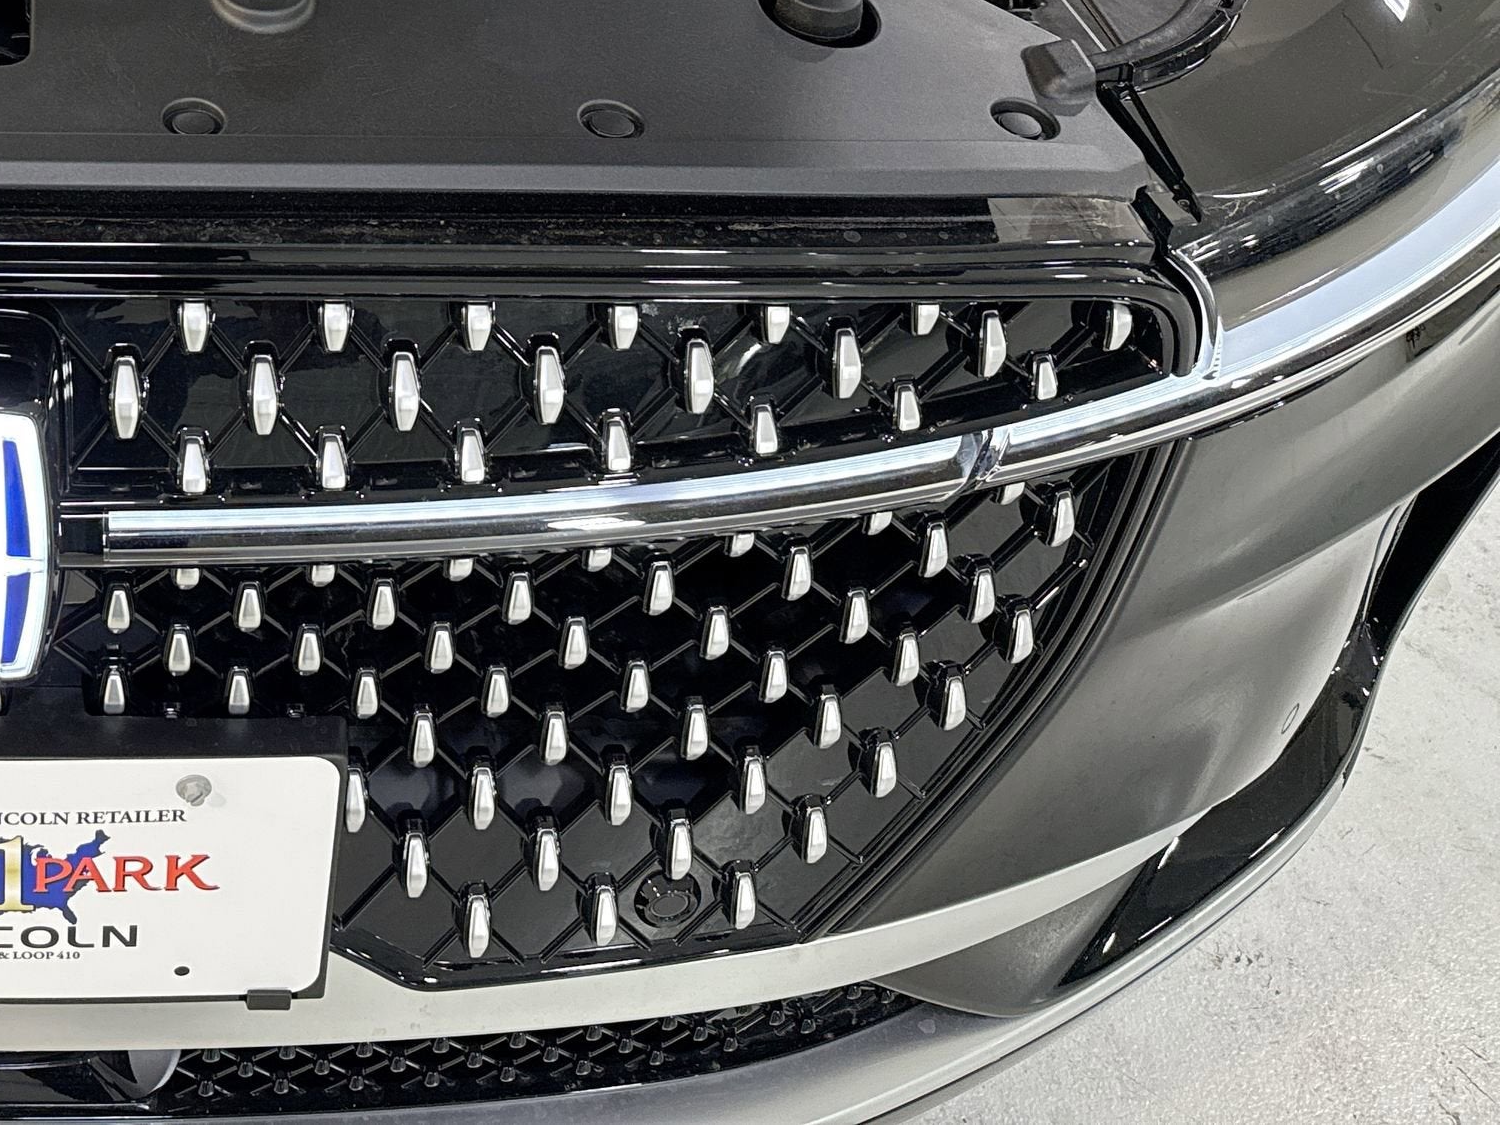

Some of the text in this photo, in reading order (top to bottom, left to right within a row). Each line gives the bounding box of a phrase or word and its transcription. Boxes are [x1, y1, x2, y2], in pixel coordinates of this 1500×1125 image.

[76, 809, 187, 825] RETAILER
[32, 854, 219, 893] PARK
[0, 951, 11, 960] &
[13, 951, 54, 960] LOOP
[57, 951, 81, 960] 410
